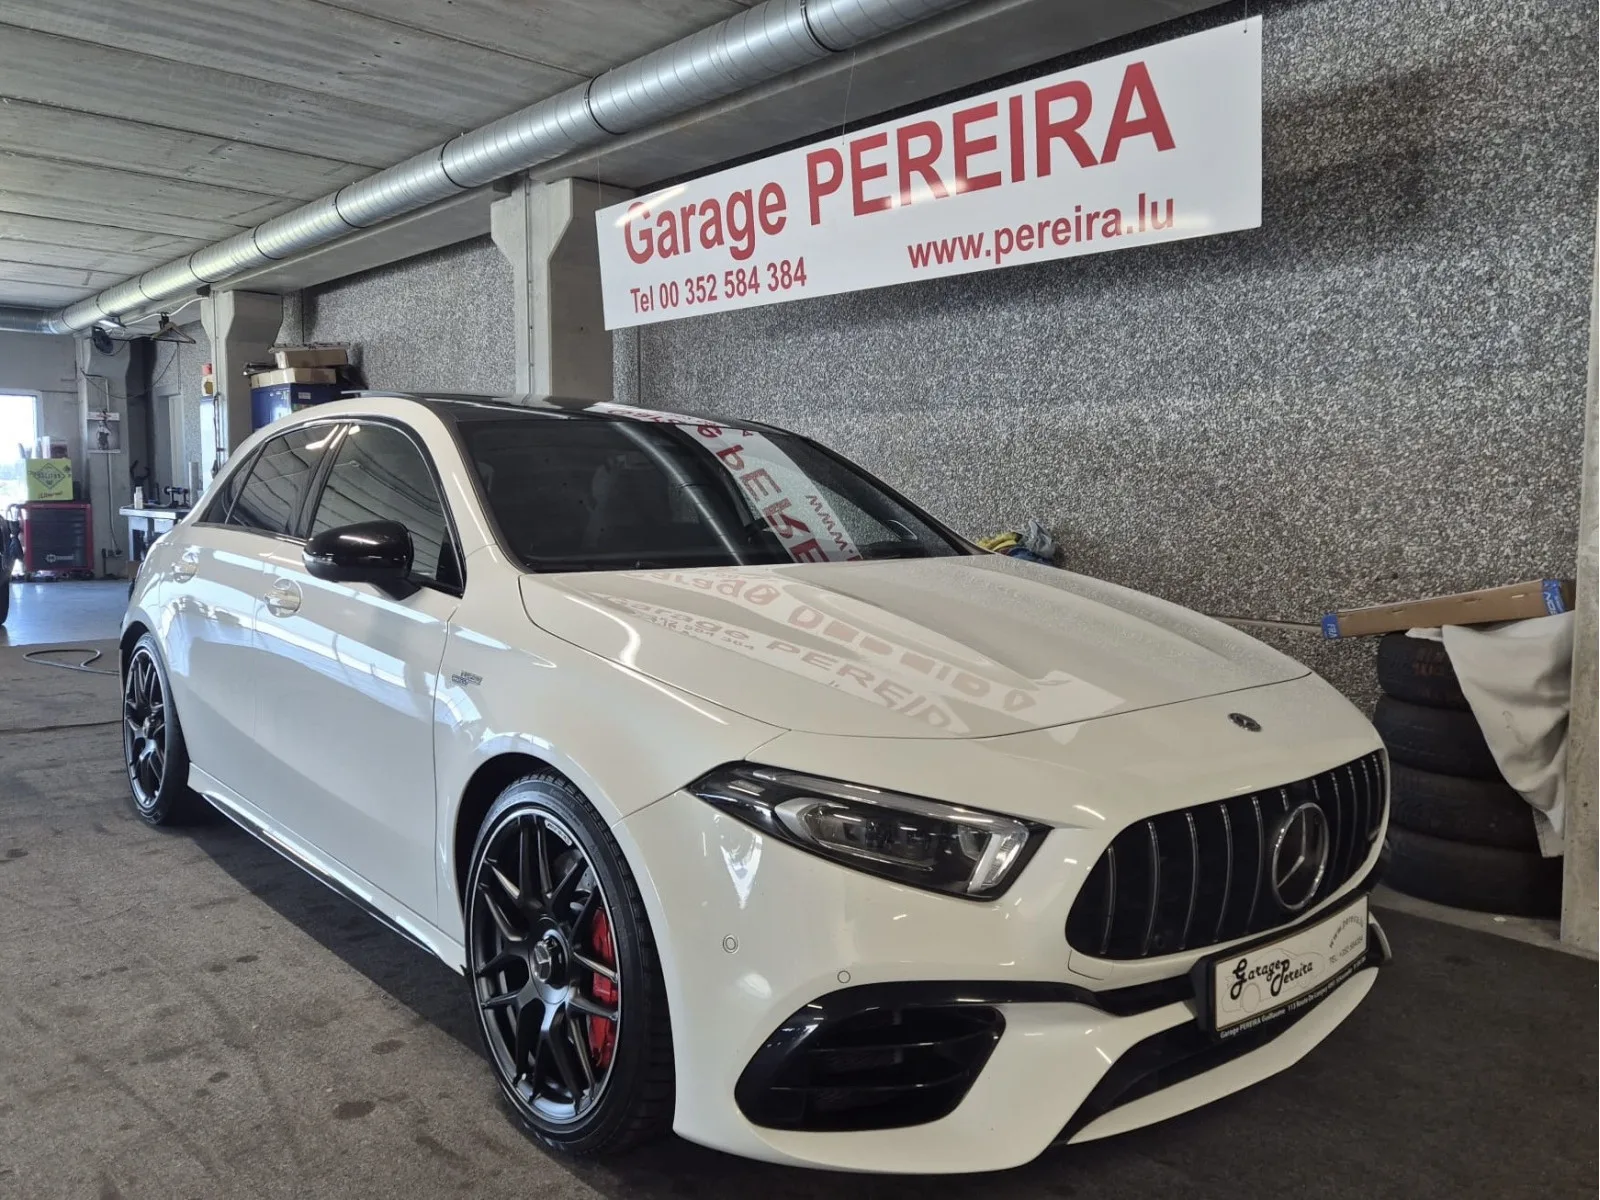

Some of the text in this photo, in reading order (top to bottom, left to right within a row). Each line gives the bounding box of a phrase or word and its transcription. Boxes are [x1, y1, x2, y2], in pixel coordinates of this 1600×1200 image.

[623, 61, 1176, 264] Garage PEREIRA
[906, 193, 1175, 269] www.pereira.lu
[630, 257, 808, 313] Tel 00 352 584 384
[1230, 958, 1281, 1000] Garage
[1270, 958, 1313, 997] Pereira
[1220, 1027, 1239, 1039] Garage
[1240, 1017, 1261, 1031] PEREIRA
